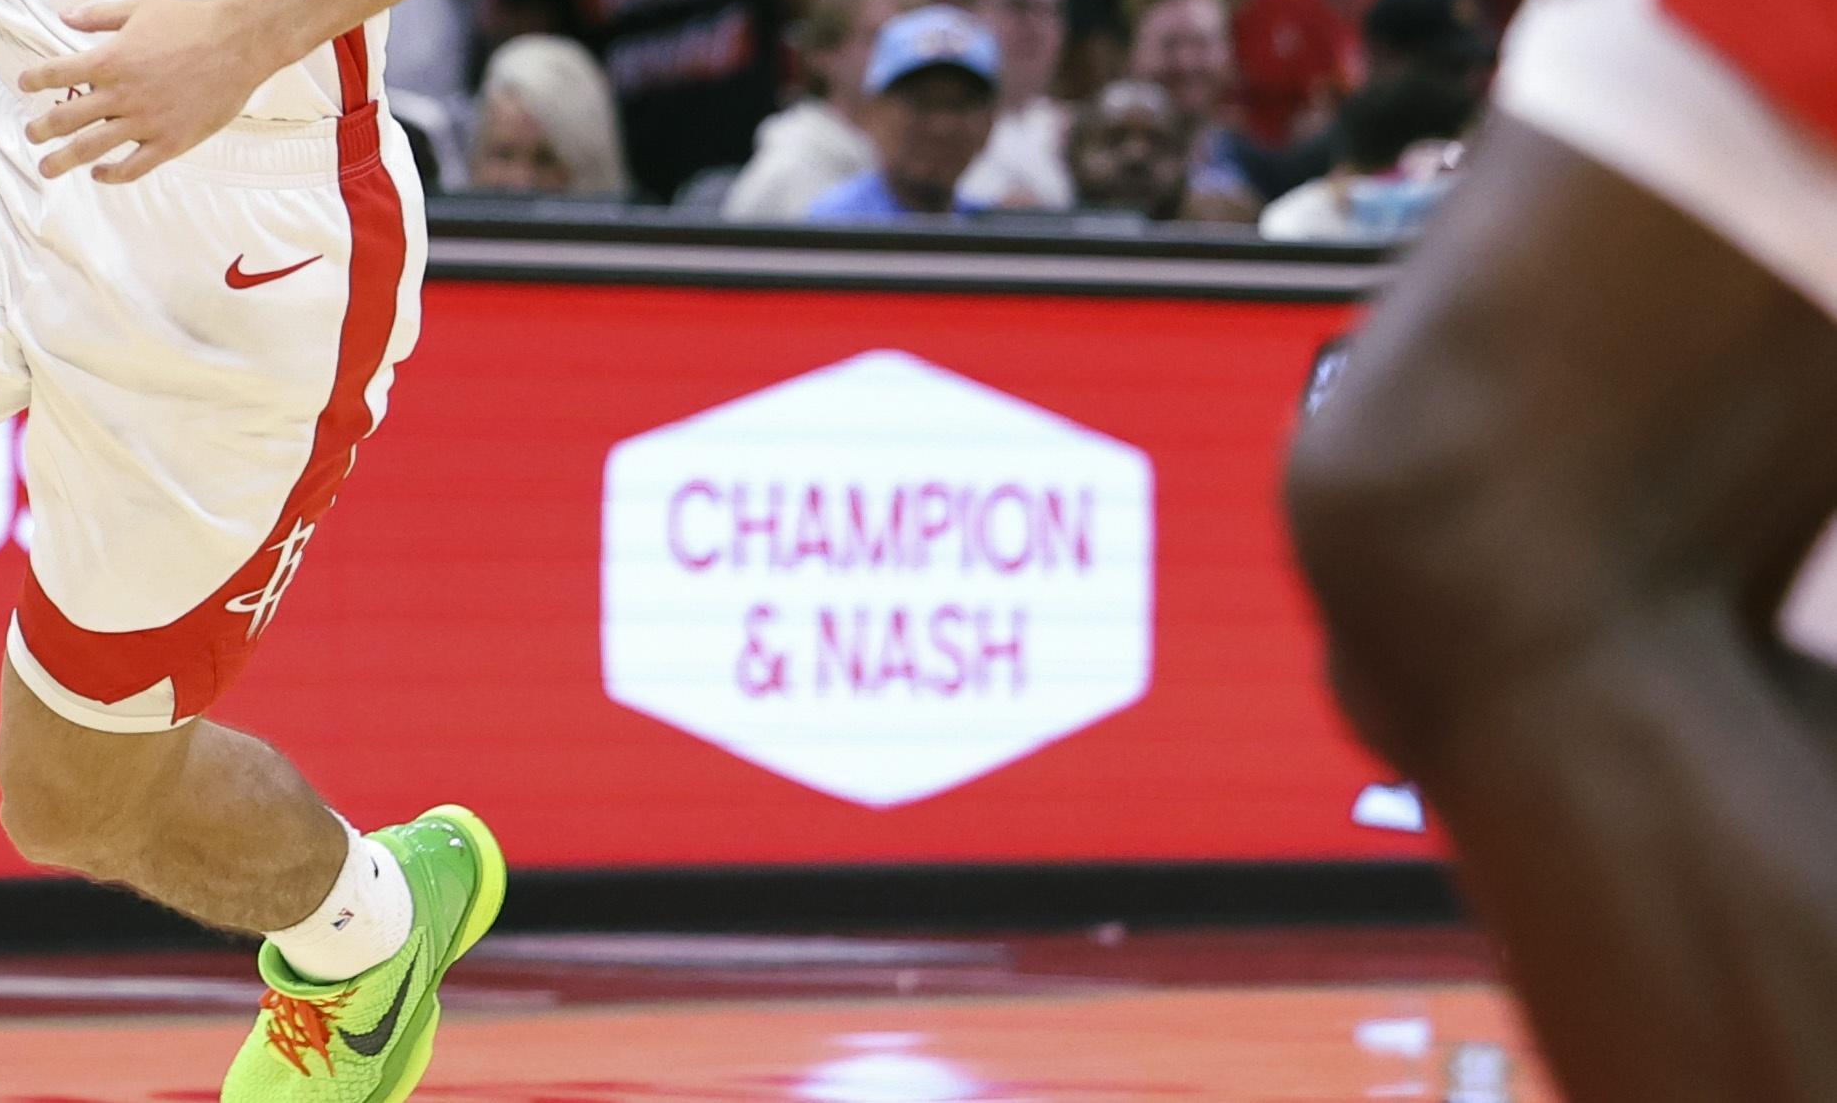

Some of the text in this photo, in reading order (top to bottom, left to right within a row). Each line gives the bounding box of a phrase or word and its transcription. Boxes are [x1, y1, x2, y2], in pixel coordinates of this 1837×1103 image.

[665, 478, 1096, 575] CHAMPION
[735, 600, 1030, 698] & NASH
